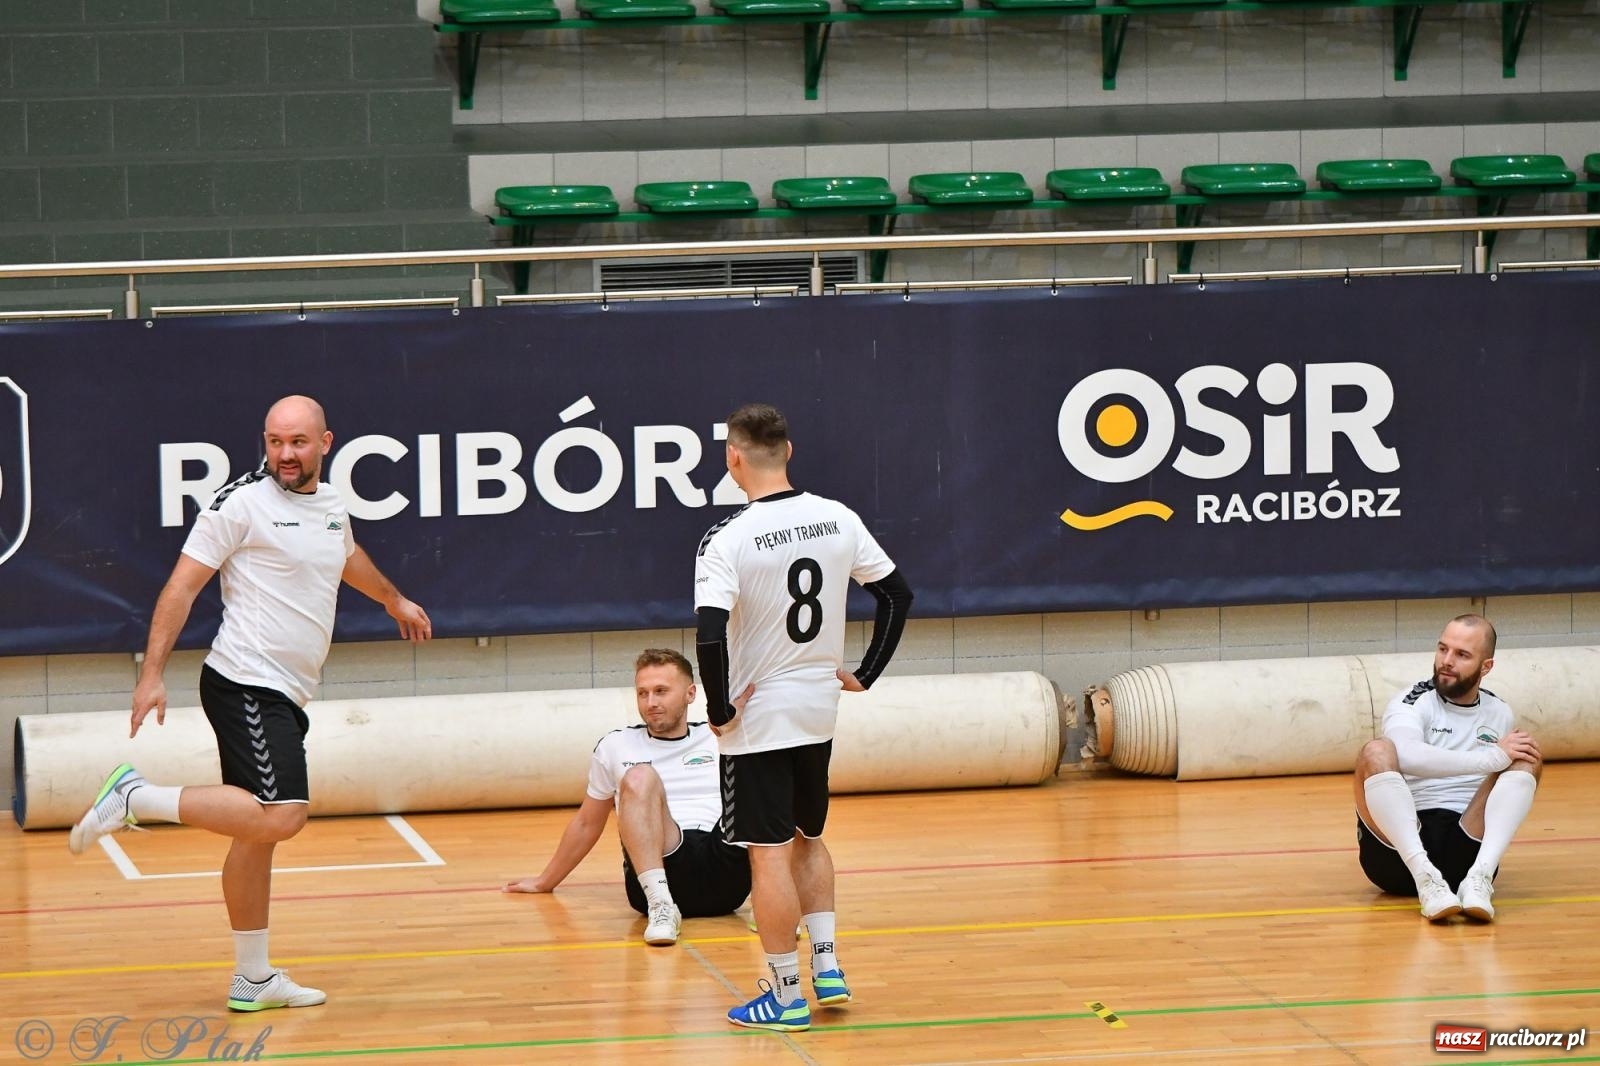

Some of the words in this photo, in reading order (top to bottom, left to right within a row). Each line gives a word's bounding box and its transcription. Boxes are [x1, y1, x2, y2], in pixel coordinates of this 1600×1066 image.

[1057, 361, 1401, 483] OSiR
[159, 395, 749, 528] RCIBÓR
[1196, 479, 1401, 524] RACIBÓRZ
[754, 529, 793, 551] PIĘKNY
[794, 520, 841, 542] TRAWNIK
[786, 557, 823, 643] 8
[814, 942, 833, 954] FS
